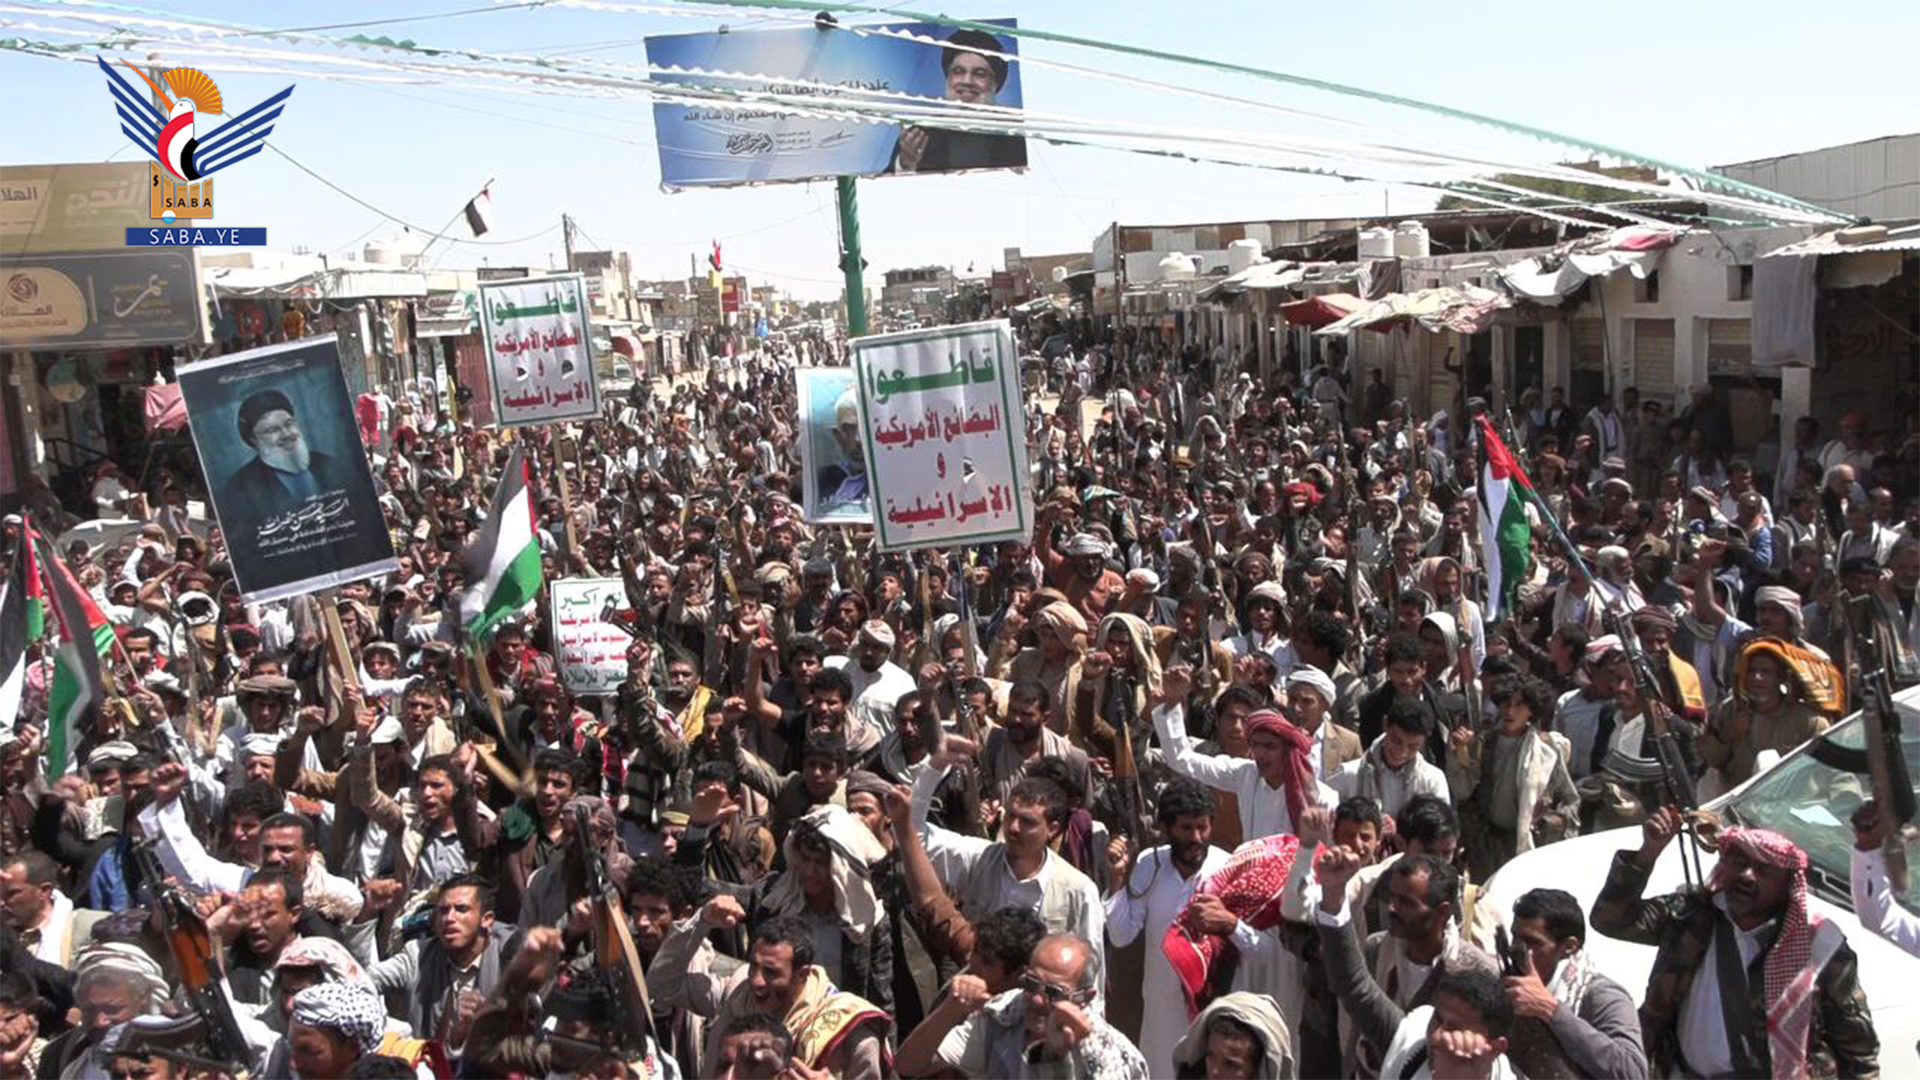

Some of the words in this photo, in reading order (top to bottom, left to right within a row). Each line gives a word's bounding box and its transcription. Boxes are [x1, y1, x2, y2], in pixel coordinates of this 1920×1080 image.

[683, 111, 700, 121] الله
[487, 289, 578, 327] قاطعوا
[493, 326, 541, 357] الأمريكية
[543, 325, 581, 353] البضائع
[538, 359, 545, 376] و
[866, 348, 996, 404] قاطعوا
[502, 380, 591, 412] الإسرائيلية
[873, 406, 940, 451] الأمريكية
[944, 403, 1000, 443] البضائع
[936, 451, 947, 480] و
[886, 483, 1013, 529] الإسرائيلية
